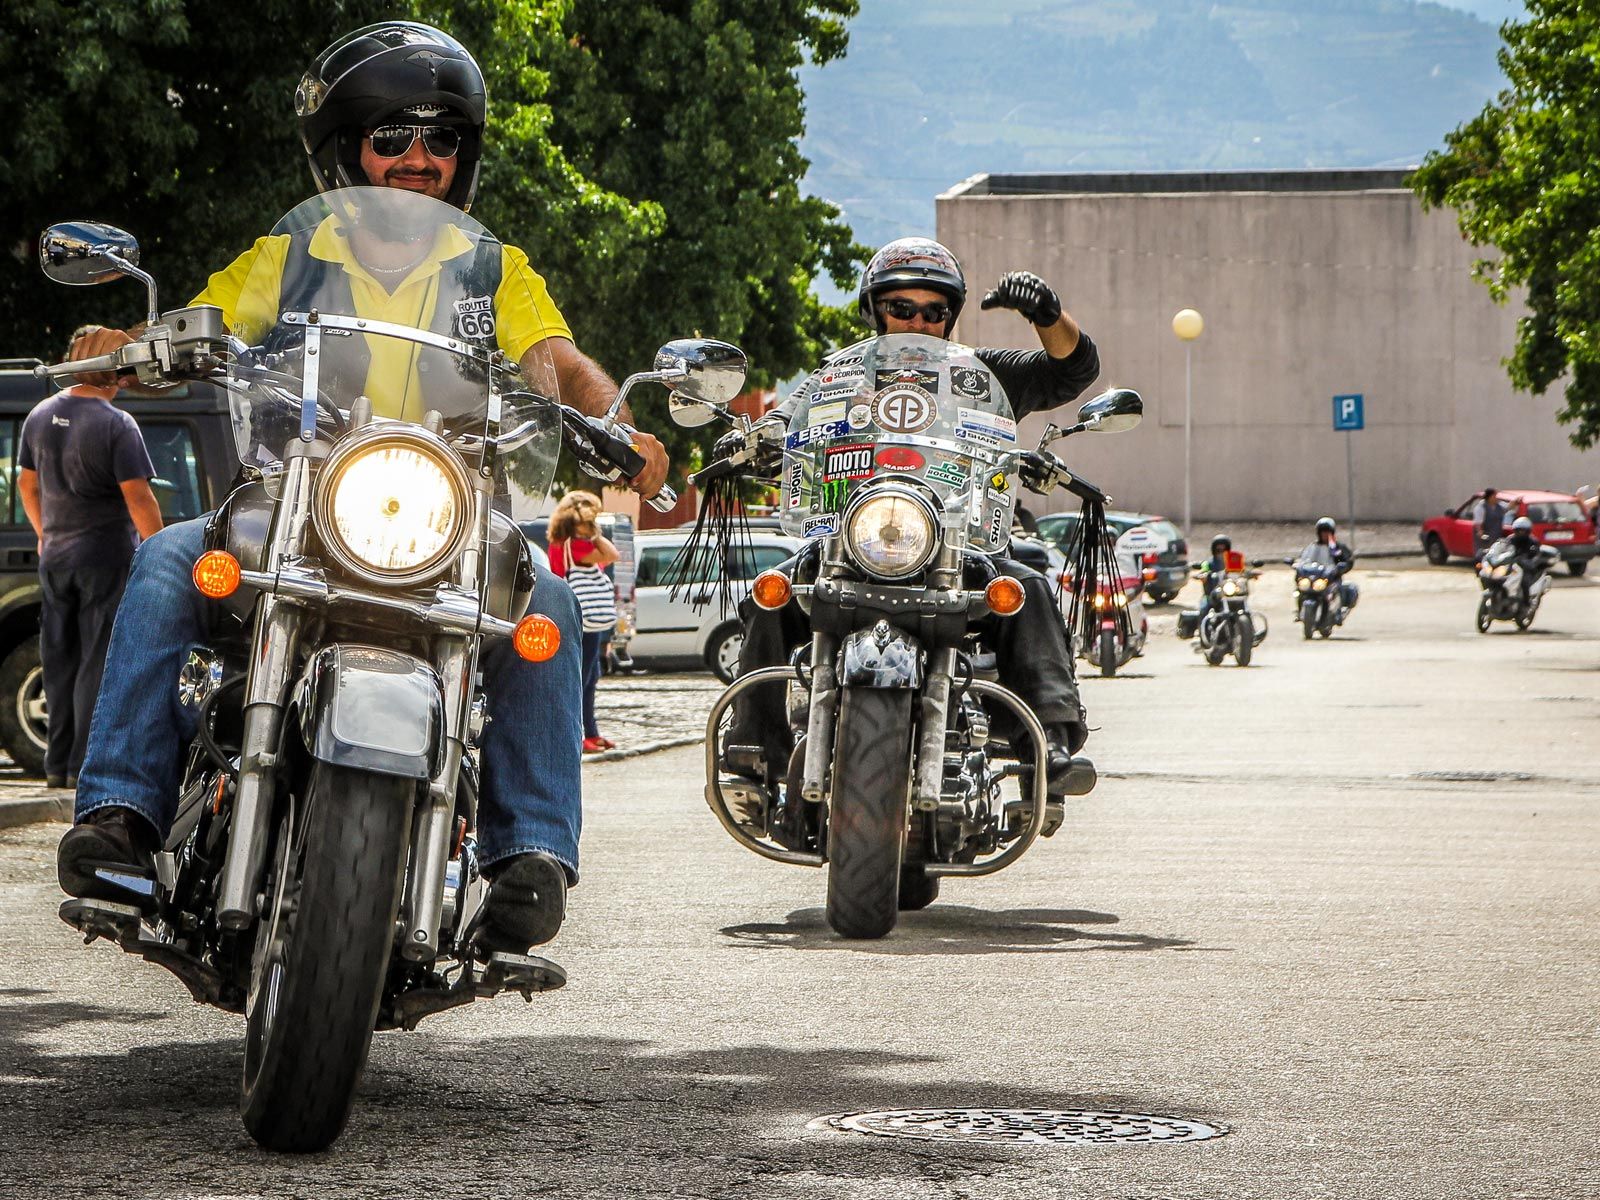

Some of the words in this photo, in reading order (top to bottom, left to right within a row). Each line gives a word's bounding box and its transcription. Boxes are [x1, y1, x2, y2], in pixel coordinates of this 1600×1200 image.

[404, 104, 449, 112] SHARK
[458, 300, 489, 312] ROUTE
[461, 312, 494, 336] 66
[834, 369, 866, 379] SCORPION
[823, 389, 855, 398] SHARK
[895, 384, 932, 403] TOURING
[1342, 398, 1355, 421] P
[798, 422, 837, 443] EBC
[967, 432, 999, 446] SHARK
[828, 450, 871, 474] MOTO
[790, 463, 802, 499] IPONE
[827, 469, 871, 481] magazine
[927, 469, 950, 479] ROCK
[951, 476, 964, 484] OIL
[991, 509, 1003, 544] SHAD
